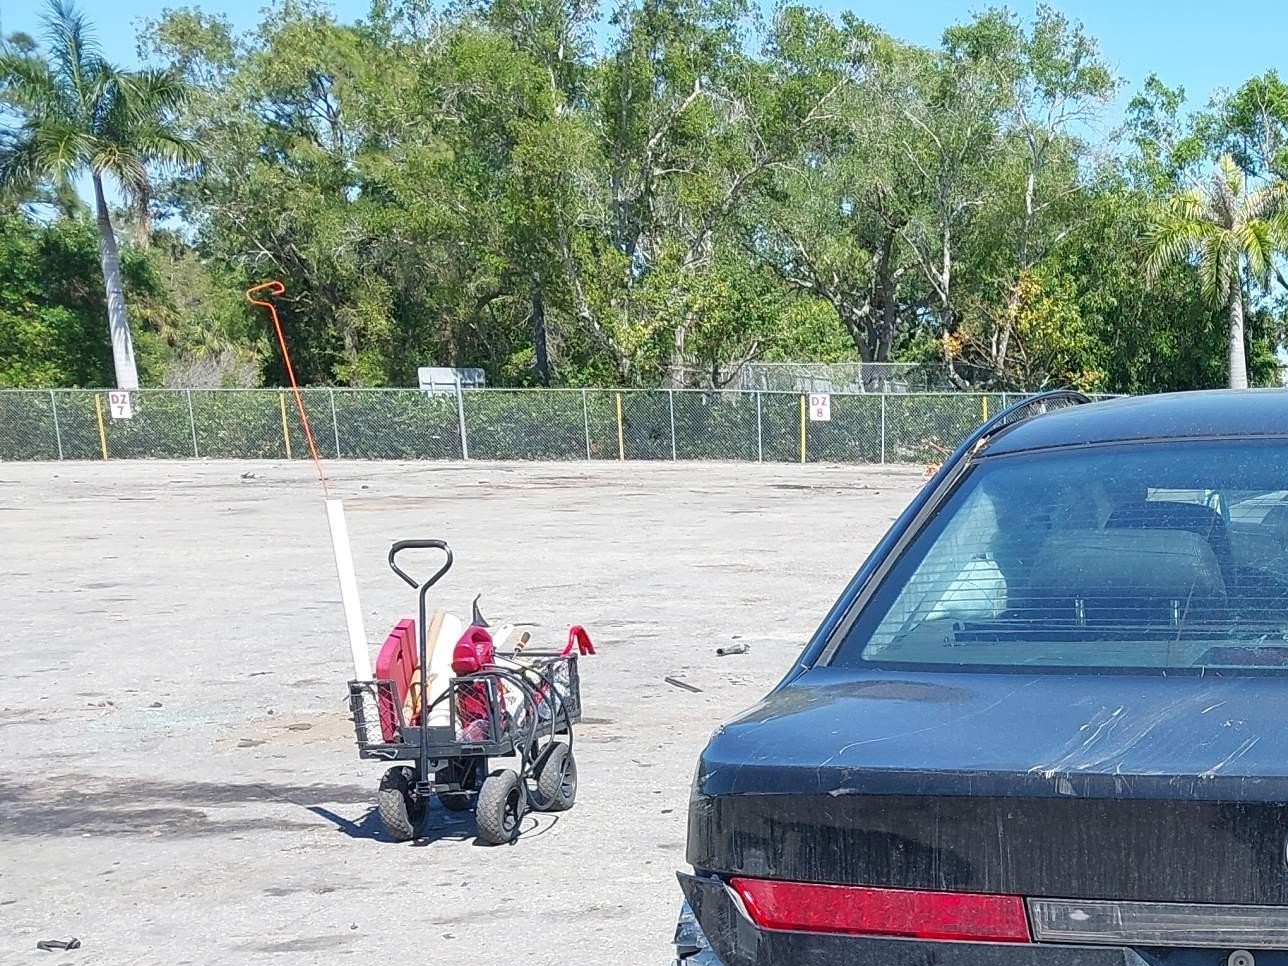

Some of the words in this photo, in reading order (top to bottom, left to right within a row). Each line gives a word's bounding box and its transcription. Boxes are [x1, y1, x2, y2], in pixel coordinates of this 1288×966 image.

[111, 394, 128, 405] DZ
[811, 396, 828, 406] DZ
[117, 406, 125, 416] 7
[816, 408, 824, 418] 8
